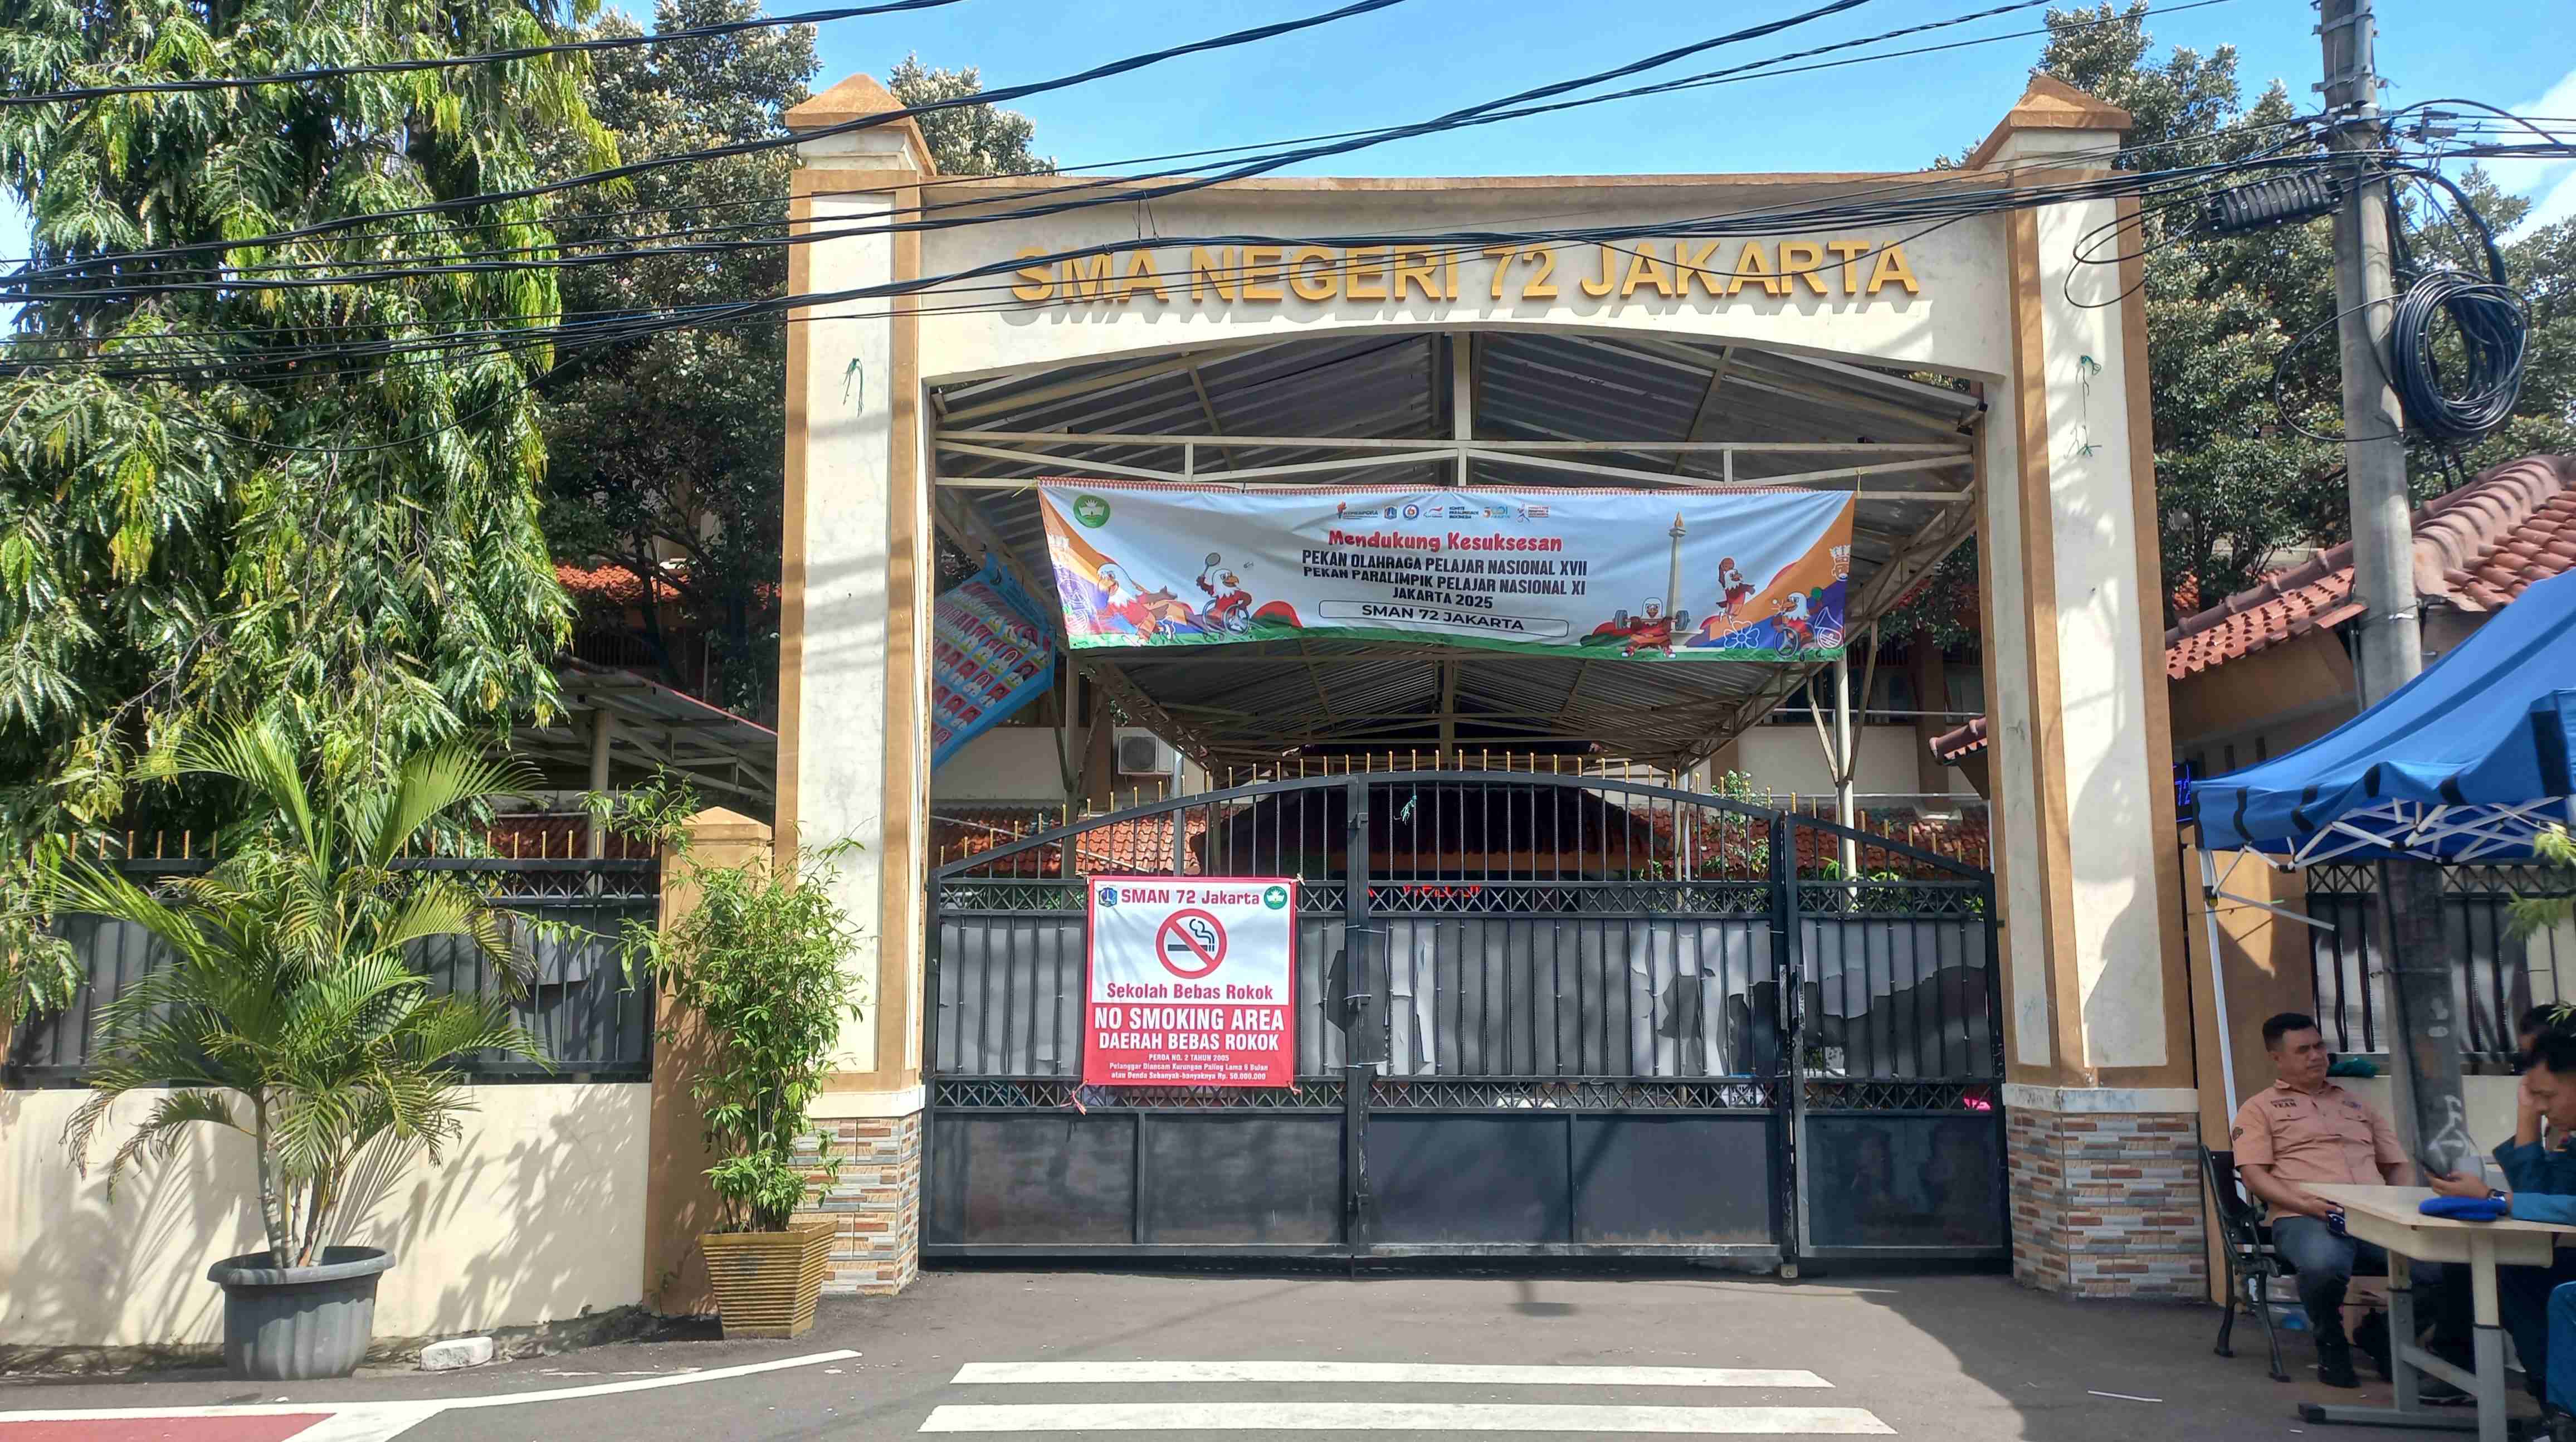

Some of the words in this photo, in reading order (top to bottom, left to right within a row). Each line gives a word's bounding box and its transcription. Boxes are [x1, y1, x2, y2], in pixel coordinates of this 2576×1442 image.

[1012, 246, 1169, 304] SMA
[1191, 245, 1457, 304] NEGERI
[1482, 245, 1558, 300] 72
[1580, 241, 1920, 299] JAKARTA
[1328, 530, 1441, 552] Mendukung
[1447, 532, 1562, 552] Kesuksesan
[1302, 549, 1347, 567] PEKAN
[1351, 554, 1422, 570] OLAHRAGA
[1425, 557, 1485, 574] PELAJAR
[1487, 559, 1555, 576] NASIONAL
[1559, 561, 1587, 576] XVII
[1304, 567, 1348, 579] PEKAN
[1352, 570, 1433, 588] PARALIMPIK
[1437, 576, 1496, 593] PELAJAR
[1499, 579, 1567, 596] NASIONAL
[1572, 581, 1586, 596] XI
[1392, 587, 1452, 605] JAKARTA
[1455, 594, 1494, 609] 2025
[1362, 605, 1413, 619] SMAN
[1419, 611, 1438, 621] 72
[1443, 612, 1524, 630] JAKARTA
[1121, 889, 1169, 904] SMAN
[1176, 890, 1196, 904] 72
[1201, 890, 1260, 905] Jakarta
[1106, 982, 1168, 999] Sekolah
[1173, 983, 1221, 1000] Bebas
[1226, 985, 1274, 1000] Rokok
[1095, 1007, 1123, 1030] NO
[1129, 1007, 1224, 1031] SMOKING
[1230, 1009, 1285, 1031] AREA
[1099, 1032, 1162, 1050] DAERAH
[1168, 1034, 1220, 1051] BEBAS
[1225, 1034, 1280, 1051] ROKOK
[1109, 1063, 1142, 1071] Pelanggar
[1204, 1063, 1224, 1071] Paling
[1149, 1072, 1216, 1080] Sebanyak-banyaknya
